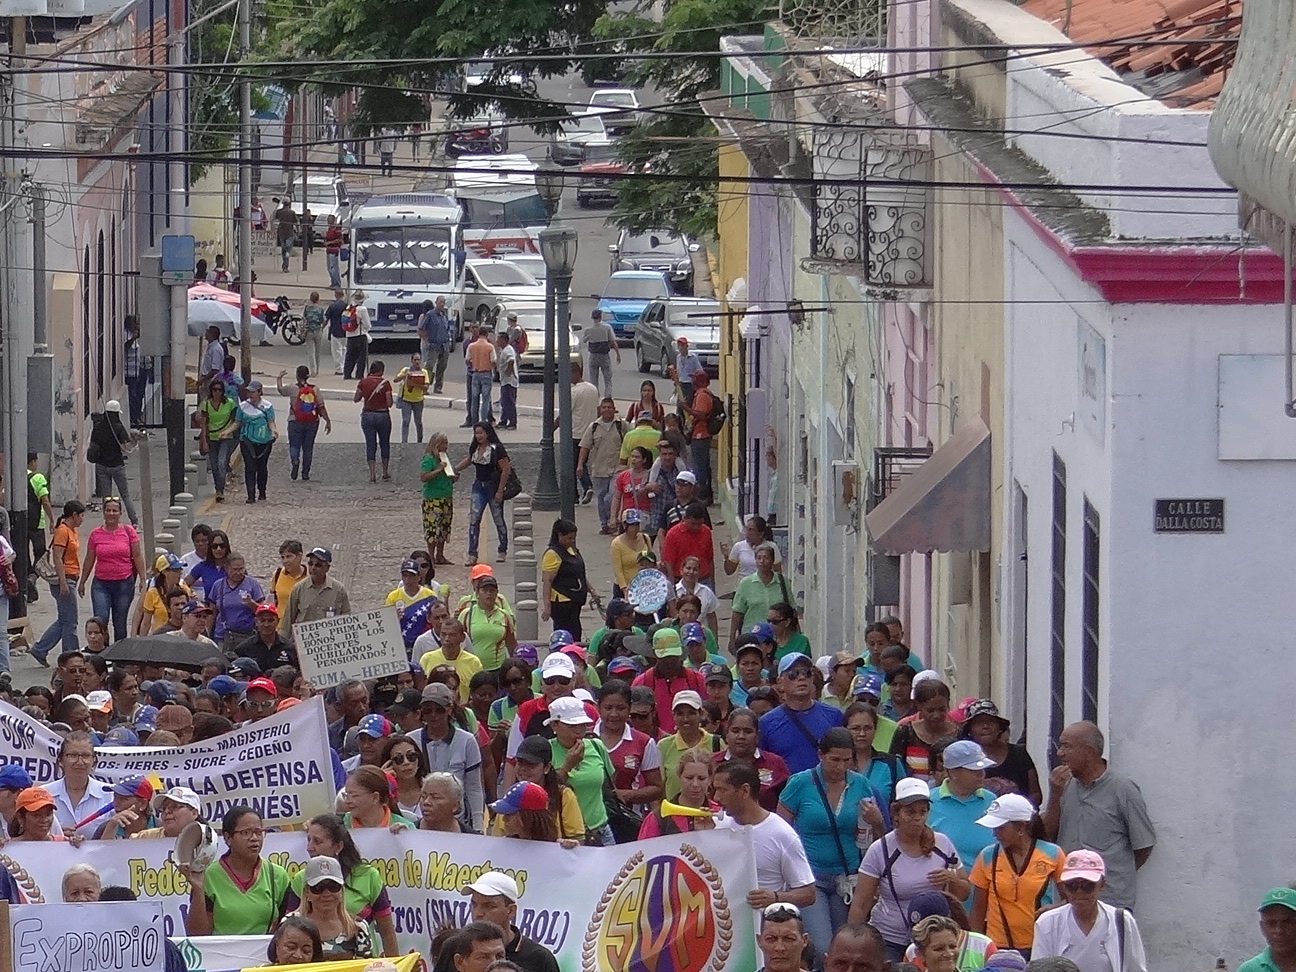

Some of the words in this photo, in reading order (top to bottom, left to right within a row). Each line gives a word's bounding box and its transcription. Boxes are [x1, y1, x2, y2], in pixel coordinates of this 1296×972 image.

[1168, 502, 1211, 515] CALLE
[367, 611, 382, 620] DE
[301, 632, 320, 641] LAS
[329, 622, 368, 636] PRIMAS
[304, 636, 335, 649] BONOS
[345, 632, 359, 641] DE
[367, 627, 385, 637] LOS
[306, 639, 360, 655] DOCENTES
[313, 644, 372, 661] JUBILADOS
[381, 641, 388, 649] Y
[0, 714, 36, 750] SUMA
[217, 723, 291, 751] MAGISTERIO
[124, 760, 169, 771] HERES
[183, 755, 227, 771] SUCRE
[239, 740, 292, 762] CEDEÑO
[191, 776, 216, 795] LA
[221, 760, 323, 792] DEFENSA
[405, 850, 423, 888] de
